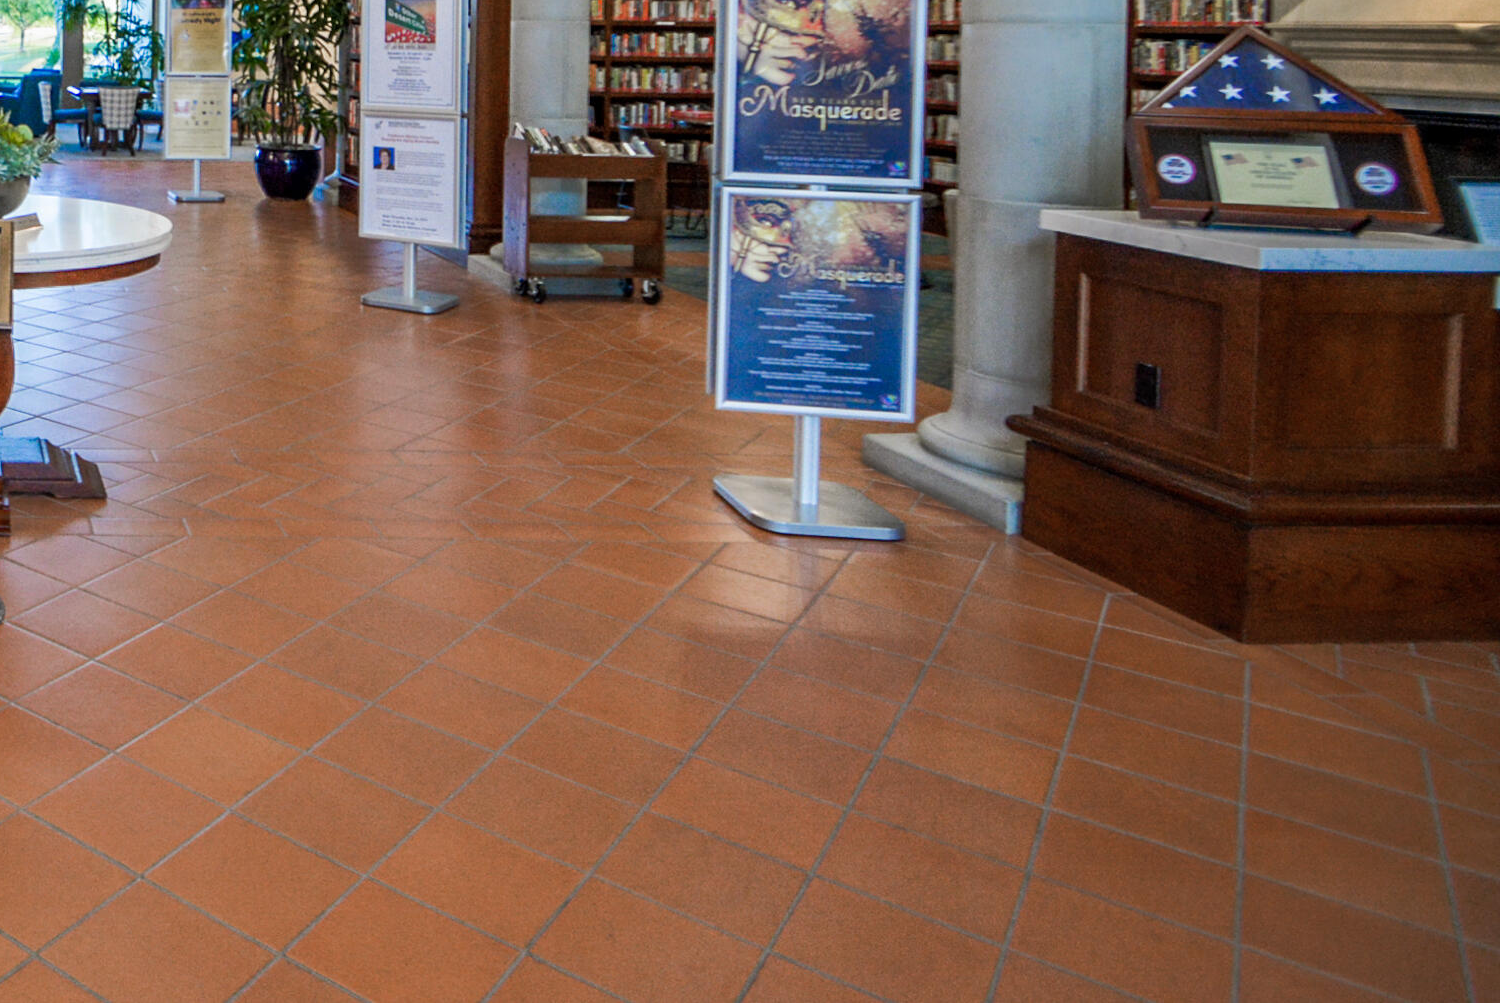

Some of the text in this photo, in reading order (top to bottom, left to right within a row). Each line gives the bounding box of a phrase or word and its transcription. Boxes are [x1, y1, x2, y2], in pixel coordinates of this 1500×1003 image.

[387, 8, 411, 23] Desert
[739, 84, 902, 131] Masquerade
[777, 253, 905, 290] Masquerade
